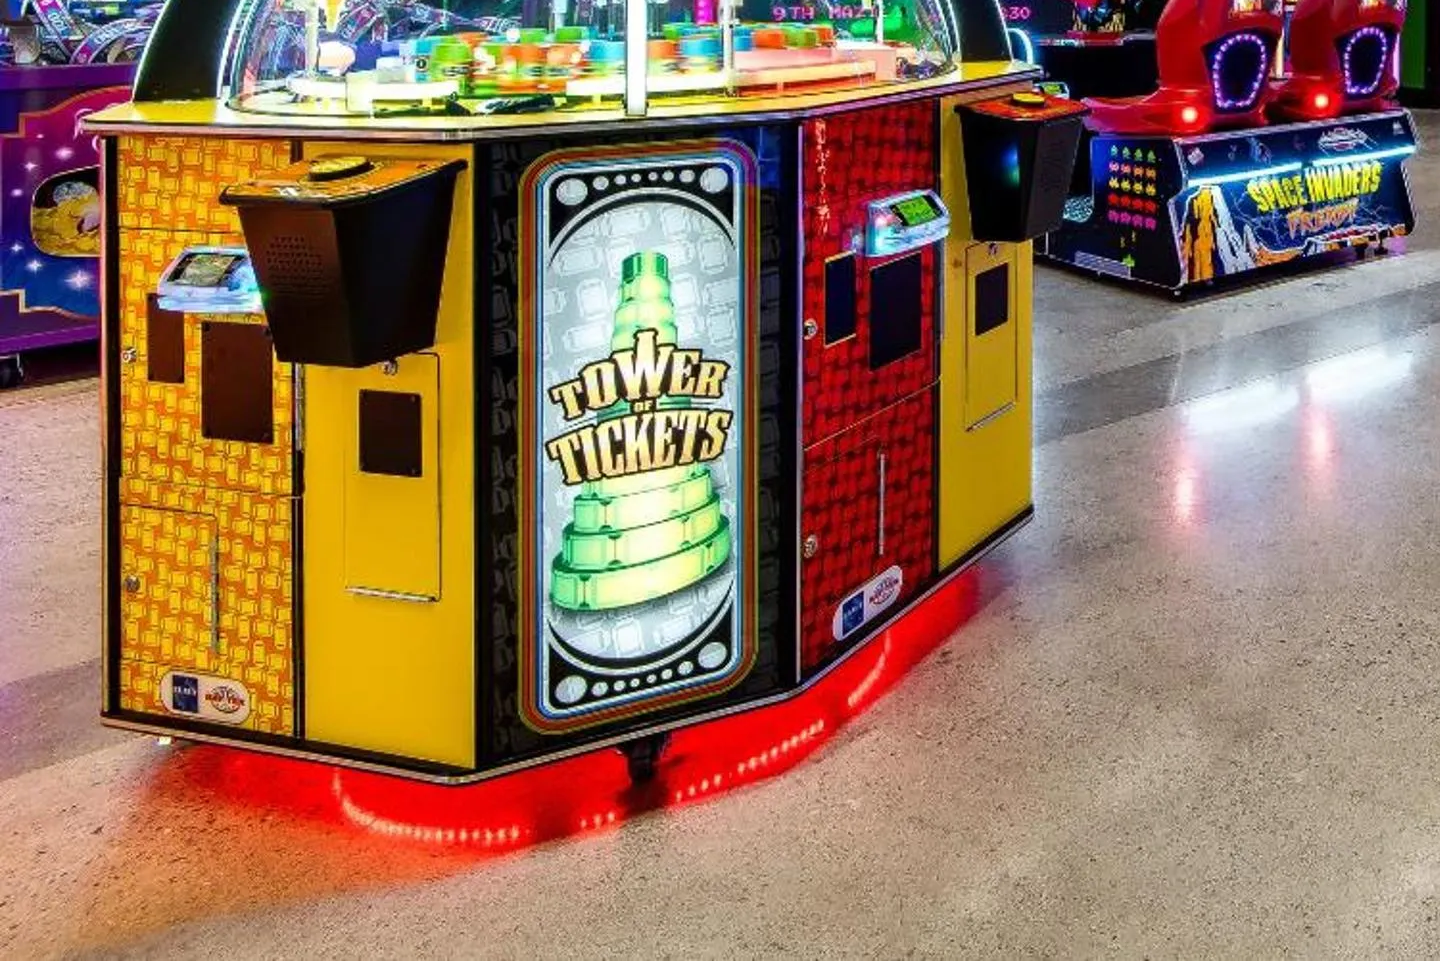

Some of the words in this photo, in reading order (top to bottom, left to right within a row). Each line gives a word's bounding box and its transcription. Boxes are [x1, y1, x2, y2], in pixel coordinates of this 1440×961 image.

[772, 6, 815, 22] 9TH
[1246, 175, 1307, 212] SPACE
[1304, 159, 1383, 201] INVADERS
[548, 328, 731, 421] TOWER
[634, 401, 653, 412] OF
[546, 410, 733, 485] TICKETS
